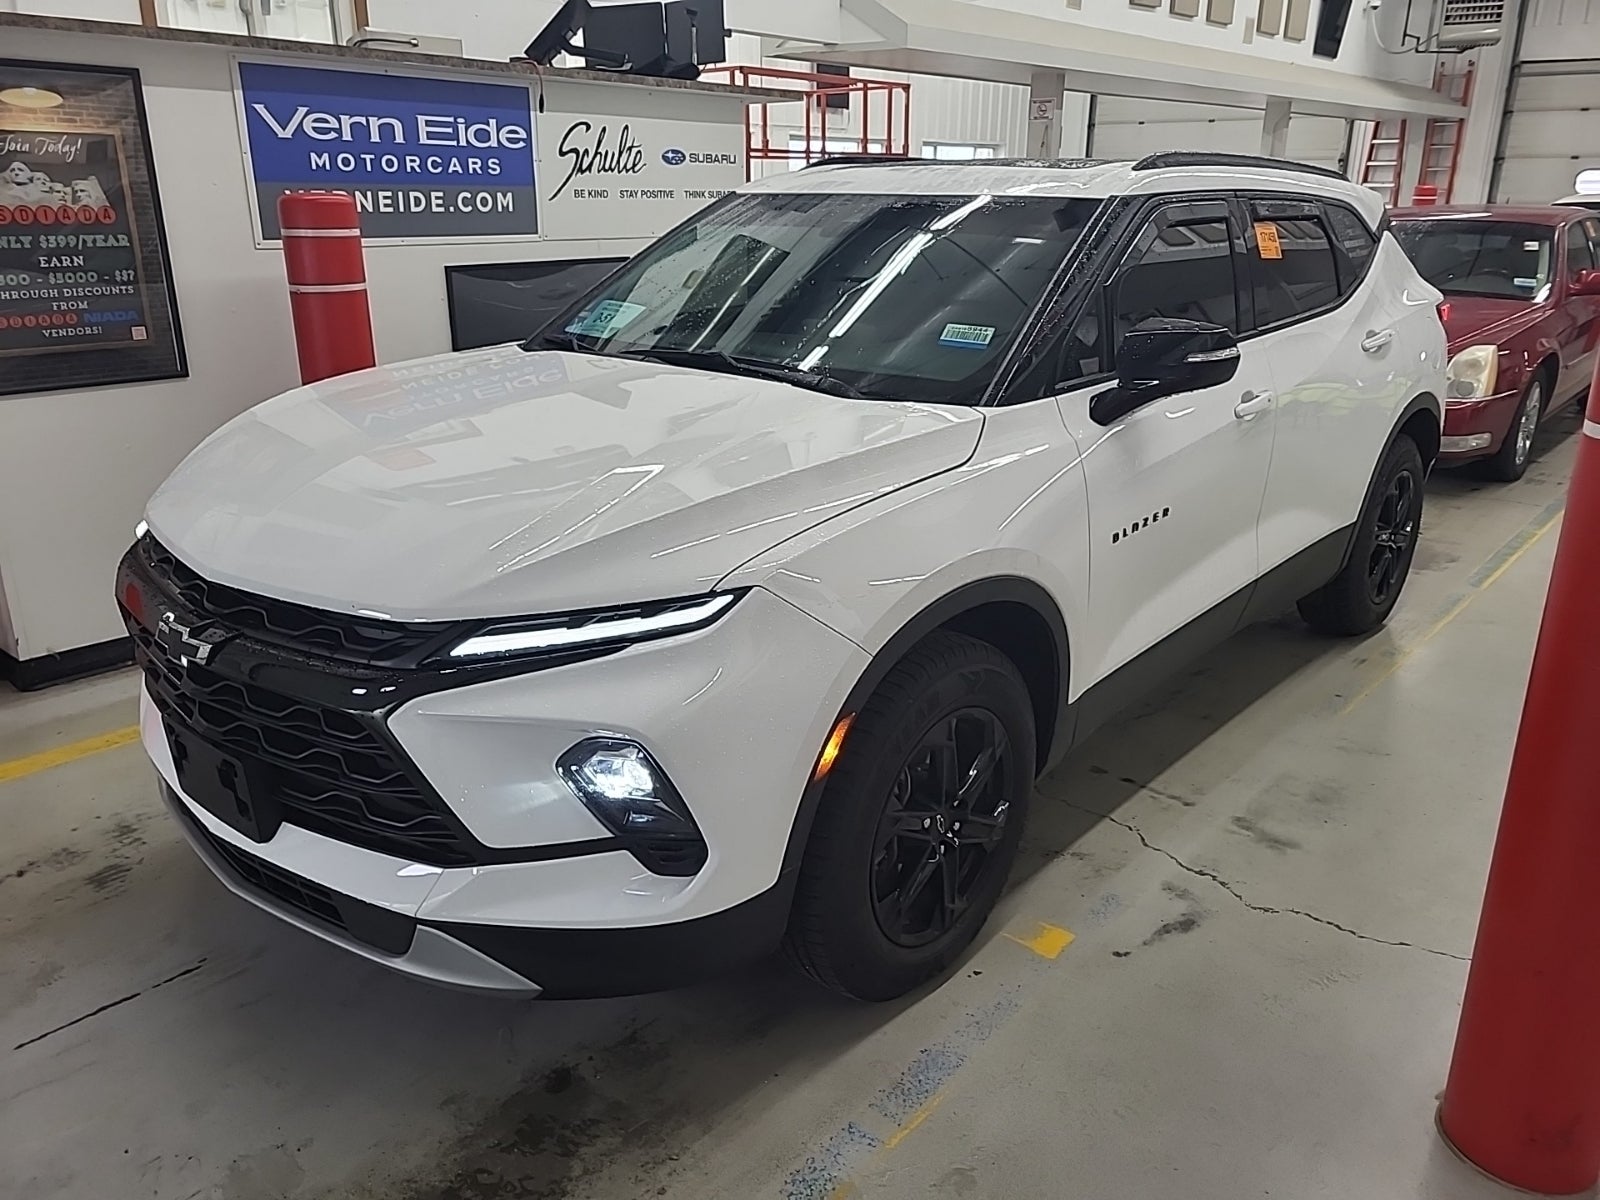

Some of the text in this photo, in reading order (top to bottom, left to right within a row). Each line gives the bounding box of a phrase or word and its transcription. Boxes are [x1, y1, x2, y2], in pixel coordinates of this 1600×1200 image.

[251, 103, 528, 149] Vern Eide
[35, 134, 82, 162] Today!
[309, 152, 501, 175] MOTORCARS
[549, 121, 647, 201] Schulte
[689, 153, 737, 165] SUBARU
[284, 189, 514, 213] NEIDE.COM
[574, 189, 608, 199] BE KIND
[619, 190, 675, 199] STAY POSITIVE
[684, 190, 706, 199] THINK
[0, 234, 130, 250] NLY $399/YEAR
[39, 255, 85, 268] EARN
[0, 285, 135, 300] HROUGH DISCOUNTS
[52, 301, 89, 311] FROM
[84, 310, 138, 323] NIADA
[42, 326, 103, 337] VENDORS!
[1112, 507, 1170, 544] BLAZER
